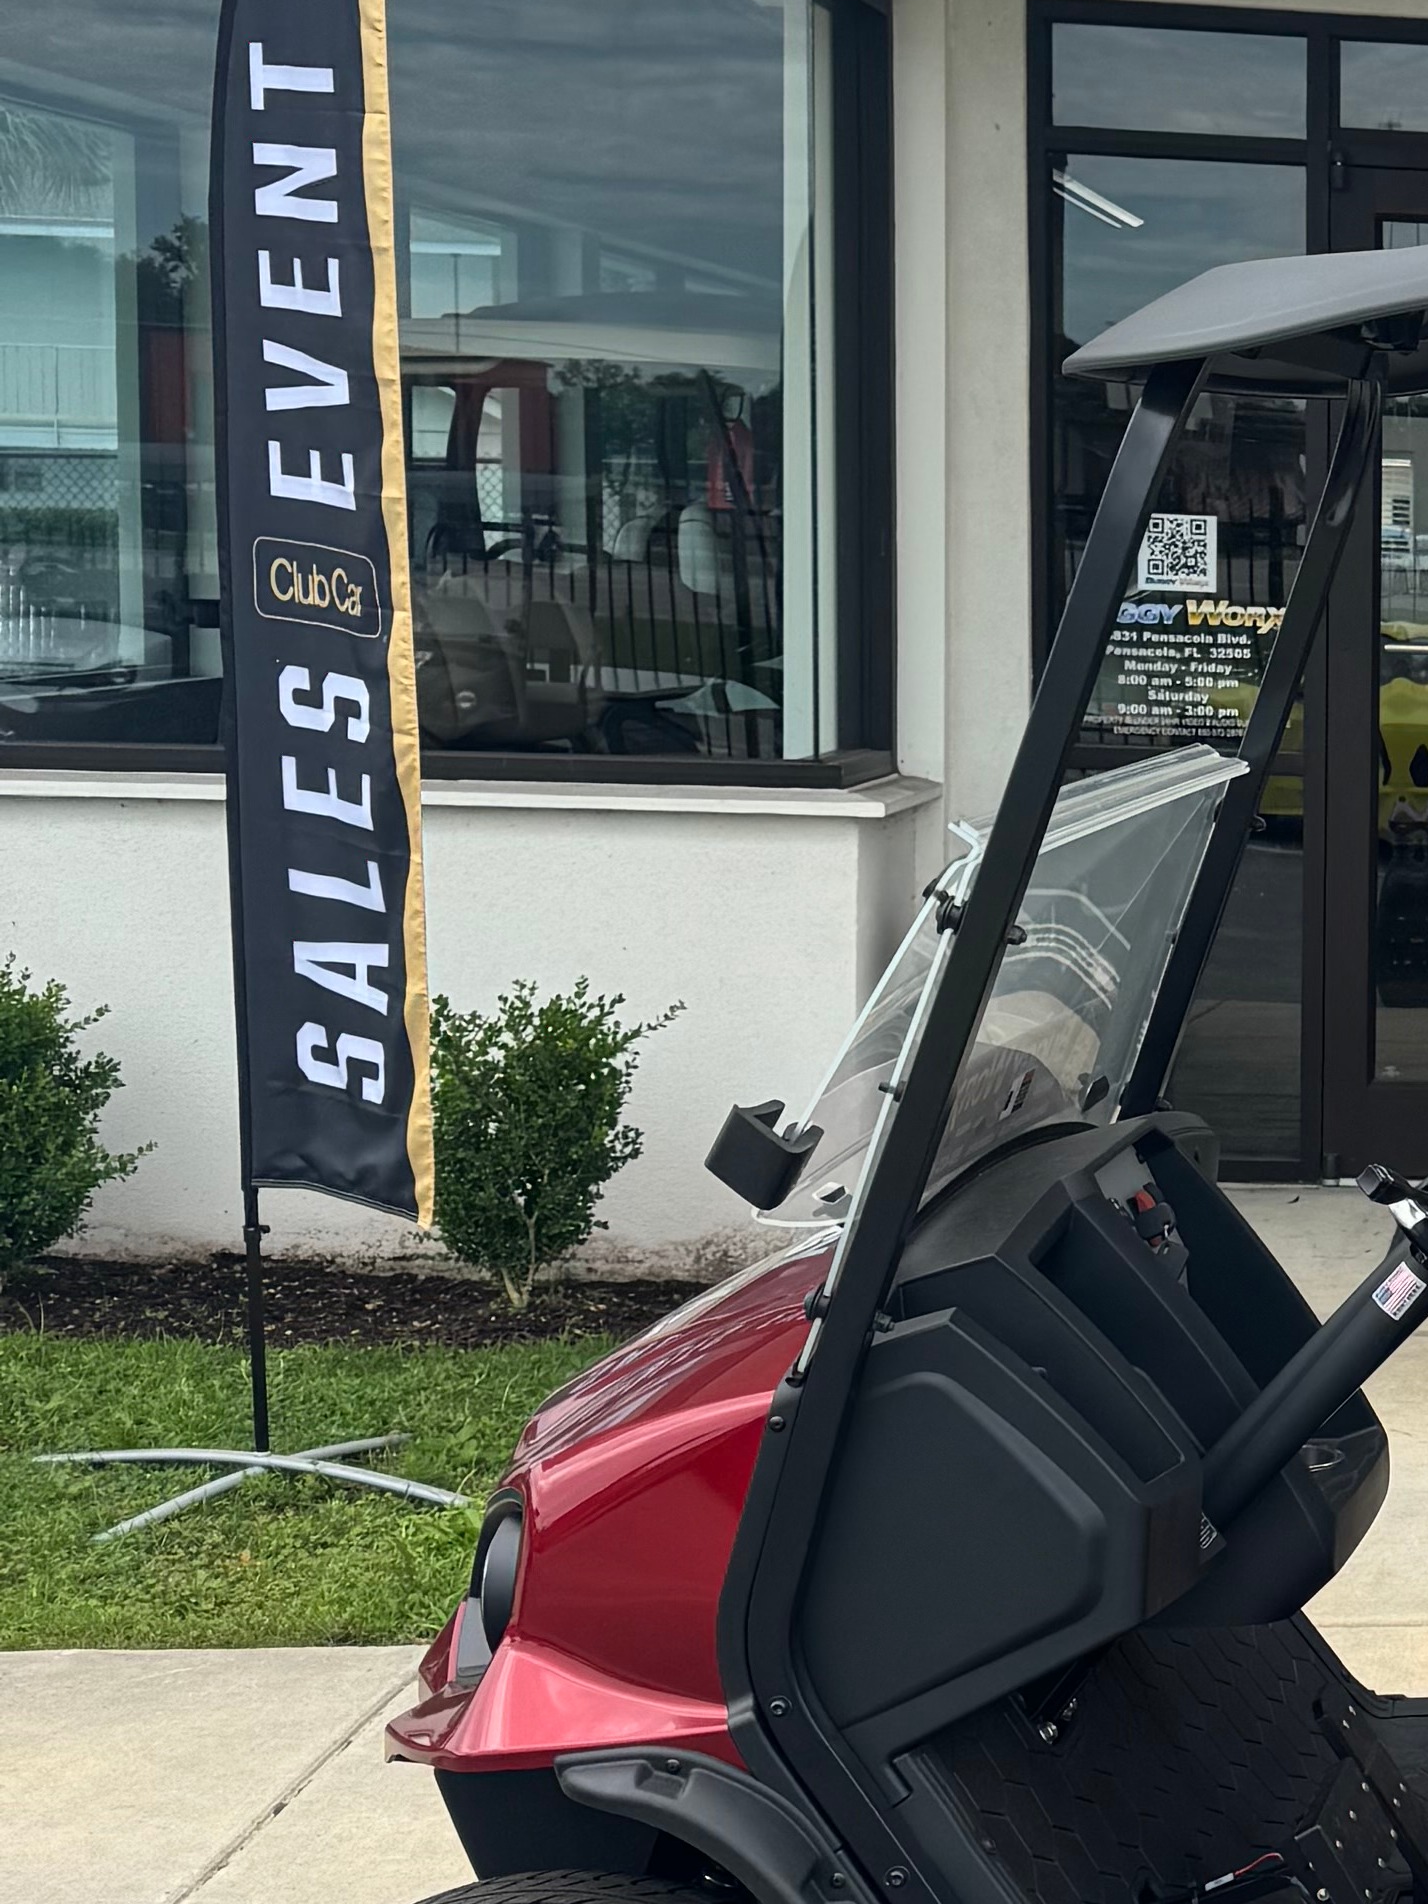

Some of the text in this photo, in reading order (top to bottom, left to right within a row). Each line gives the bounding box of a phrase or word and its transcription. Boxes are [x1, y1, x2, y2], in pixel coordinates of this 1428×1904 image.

[249, 42, 389, 1103] SALES EVENT
[270, 558, 362, 617] Club Car
[1116, 600, 1286, 634] GGY WORX
[1143, 632, 1214, 644] Pensacola
[1217, 633, 1251, 645] Blvd.
[1185, 648, 1201, 658] FL
[1210, 648, 1251, 659] 32505
[1124, 660, 1178, 674] Monday
[1190, 662, 1232, 675] Friday
[1118, 675, 1147, 686] 8:00
[1151, 678, 1172, 687] am
[1185, 677, 1214, 688] 5:00
[1218, 679, 1239, 689] pm
[1148, 689, 1209, 704] Saturday
[1118, 704, 1147, 715] 9:00
[1151, 706, 1173, 716] am
[1185, 706, 1214, 716] 3:00
[1218, 707, 1239, 718] pm
